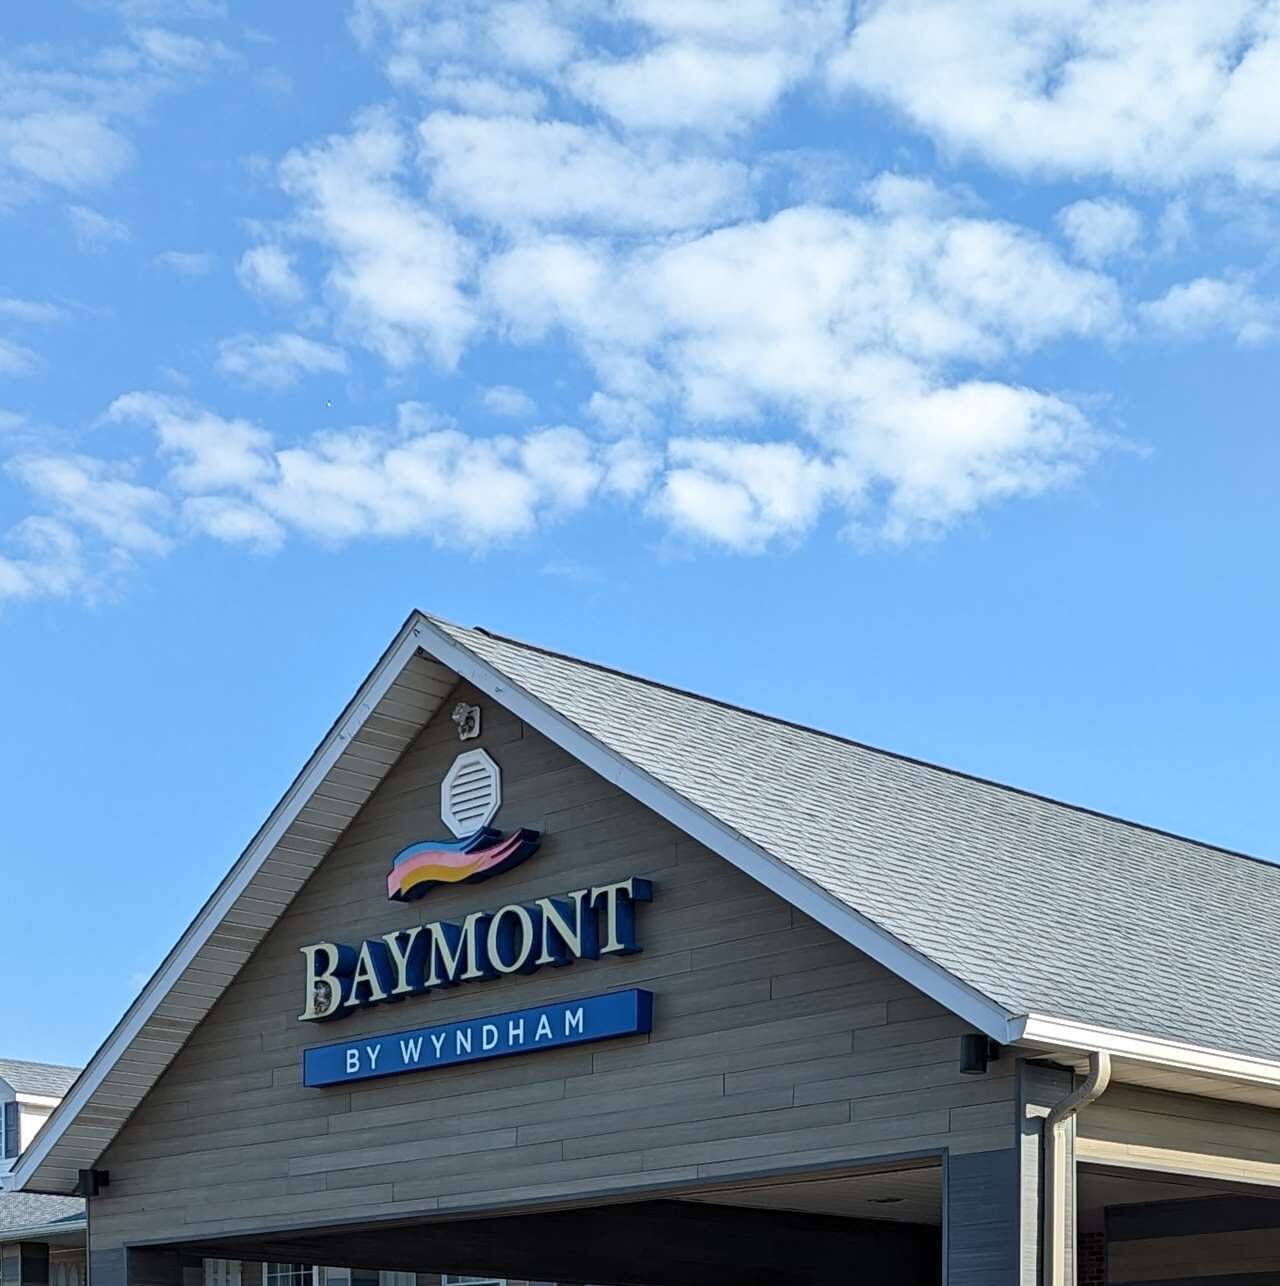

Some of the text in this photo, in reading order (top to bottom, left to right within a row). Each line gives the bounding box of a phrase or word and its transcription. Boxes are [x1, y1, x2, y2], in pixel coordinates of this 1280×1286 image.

[298, 877, 638, 1022] BAYMONT
[345, 1007, 584, 1074] BY WYNDHAM
